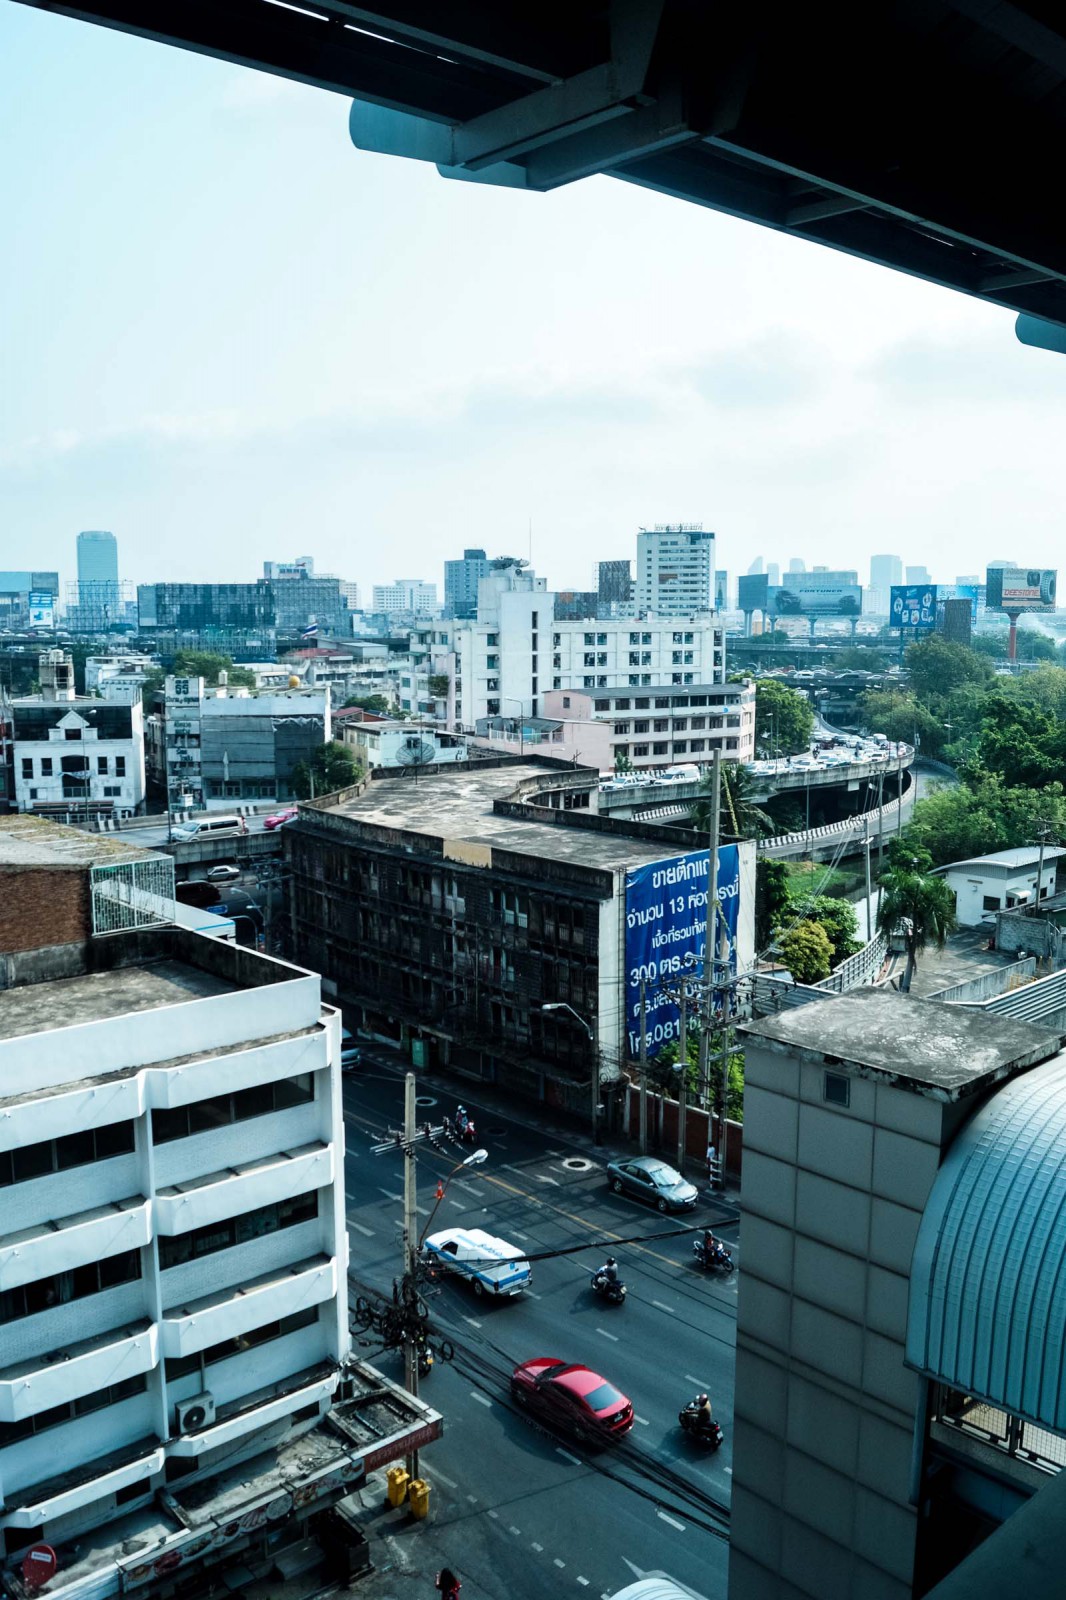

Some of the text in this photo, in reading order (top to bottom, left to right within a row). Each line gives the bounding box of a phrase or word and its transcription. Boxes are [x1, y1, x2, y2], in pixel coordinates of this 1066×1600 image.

[626, 903, 664, 929] จำนวน
[669, 895, 685, 914] 13
[630, 961, 657, 987] 300
